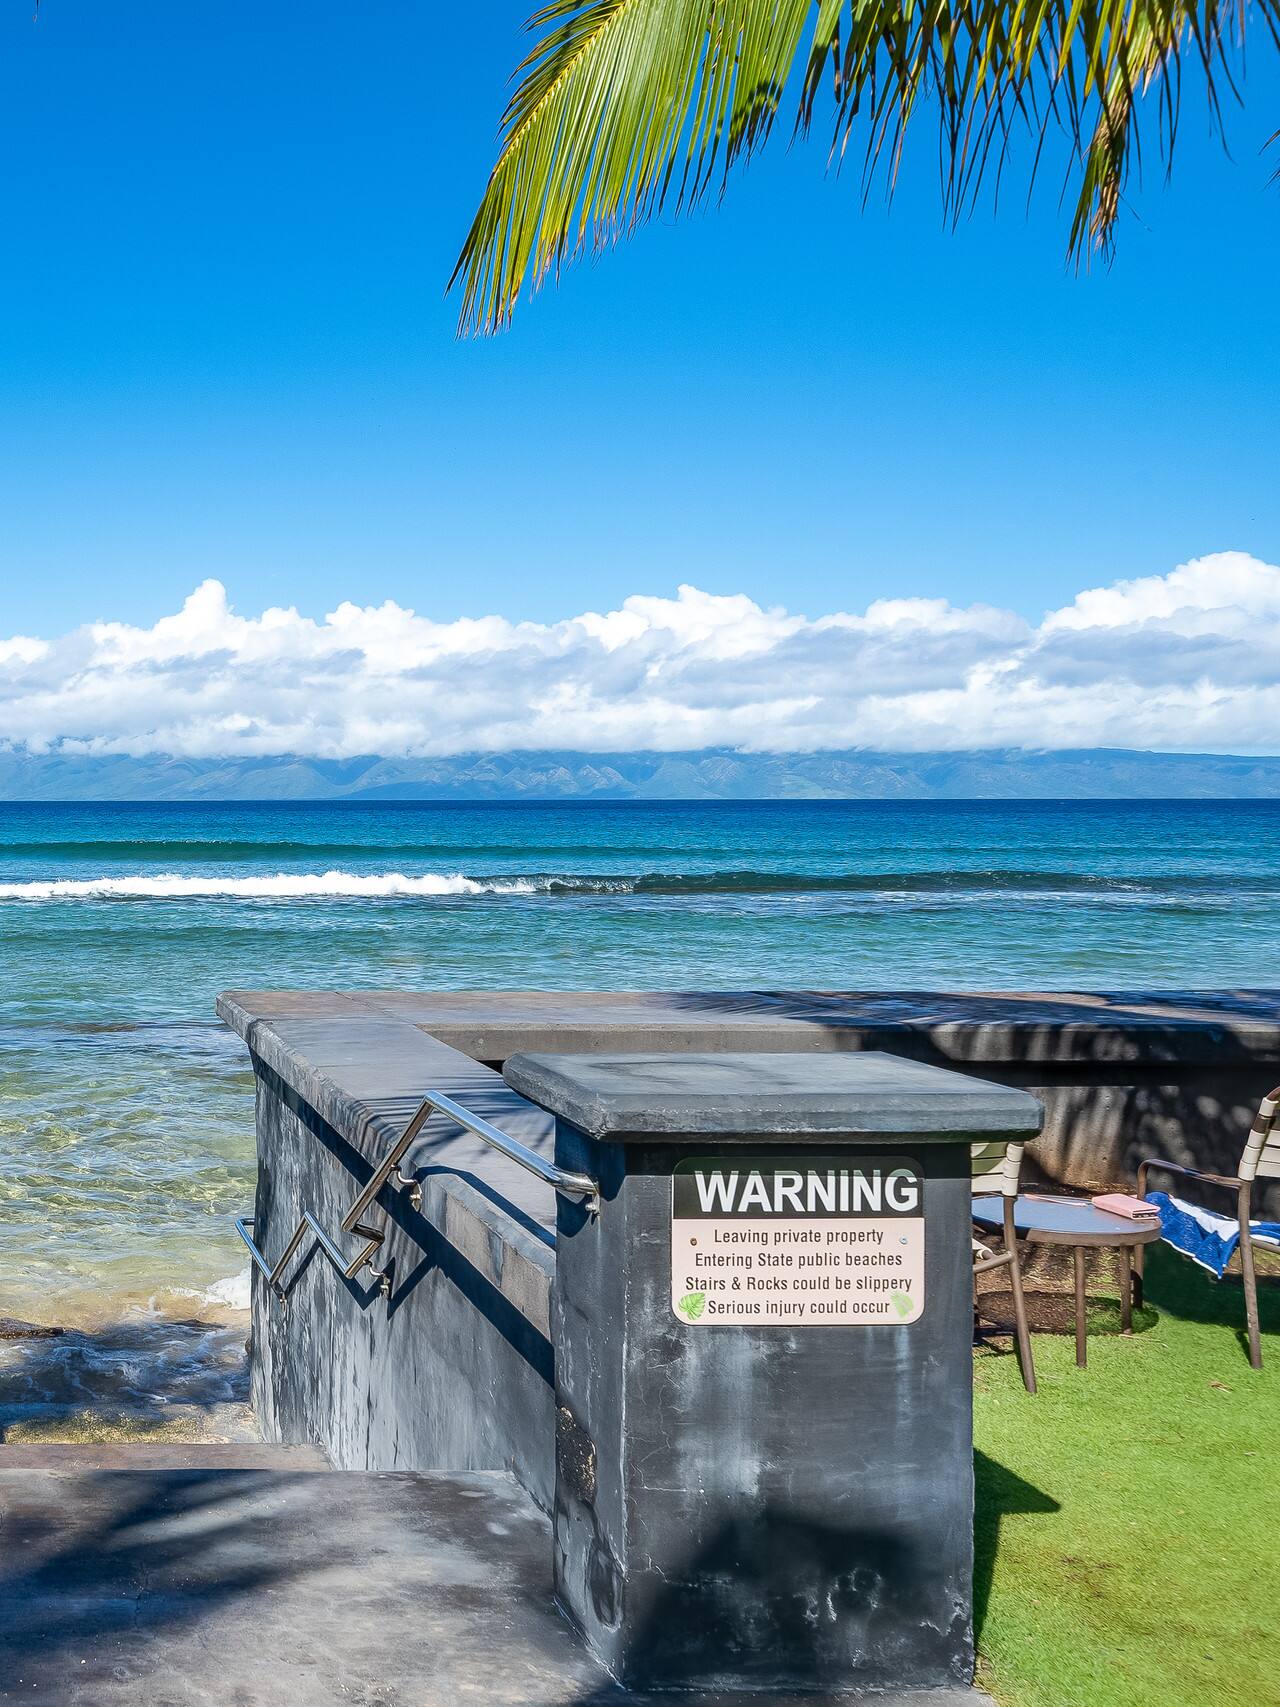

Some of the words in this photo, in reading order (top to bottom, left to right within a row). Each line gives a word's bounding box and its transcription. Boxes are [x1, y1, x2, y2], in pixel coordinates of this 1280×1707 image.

[694, 1169, 918, 1213] WARNING
[714, 1229, 768, 1245] Leaving
[774, 1229, 821, 1245] private
[826, 1229, 884, 1245] property
[695, 1252, 752, 1269] Entering
[758, 1253, 793, 1267] State
[798, 1252, 840, 1269] public
[845, 1252, 902, 1266] beaches
[686, 1277, 726, 1290] Stairs
[731, 1277, 741, 1290] &
[747, 1277, 788, 1290] Rocks
[793, 1276, 830, 1290] could
[835, 1276, 851, 1290] be
[856, 1276, 912, 1292] slippery
[708, 1301, 760, 1314] Serious
[766, 1301, 805, 1316] injury
[810, 1300, 847, 1314] could
[852, 1302, 890, 1314] occur
